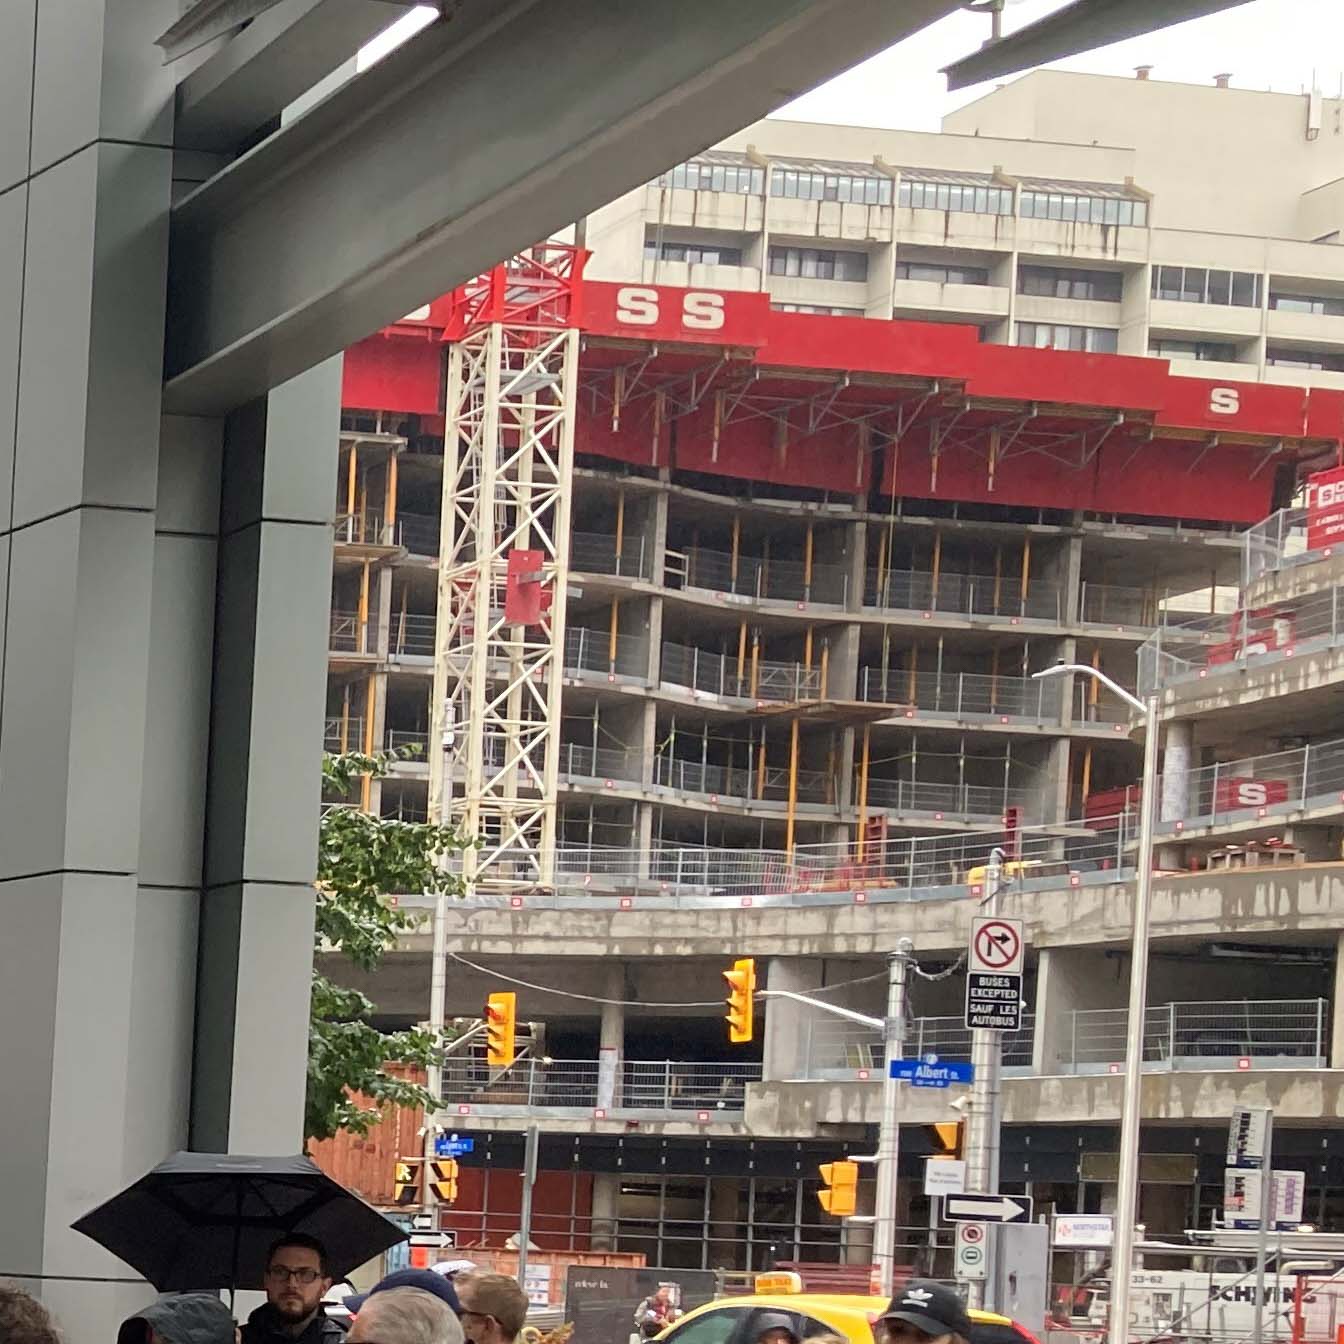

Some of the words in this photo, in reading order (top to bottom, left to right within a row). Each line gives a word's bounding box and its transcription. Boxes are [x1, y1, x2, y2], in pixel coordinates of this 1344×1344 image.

[1211, 387, 1239, 414] S
[1238, 783, 1267, 805] S
[979, 976, 1010, 987] BUSES
[970, 988, 1018, 999] EXCEPTED
[970, 1003, 994, 1014] SAUF
[999, 1004, 1018, 1015] LES
[972, 1015, 1015, 1026] AUTOBUS
[915, 1064, 949, 1079] Albert
